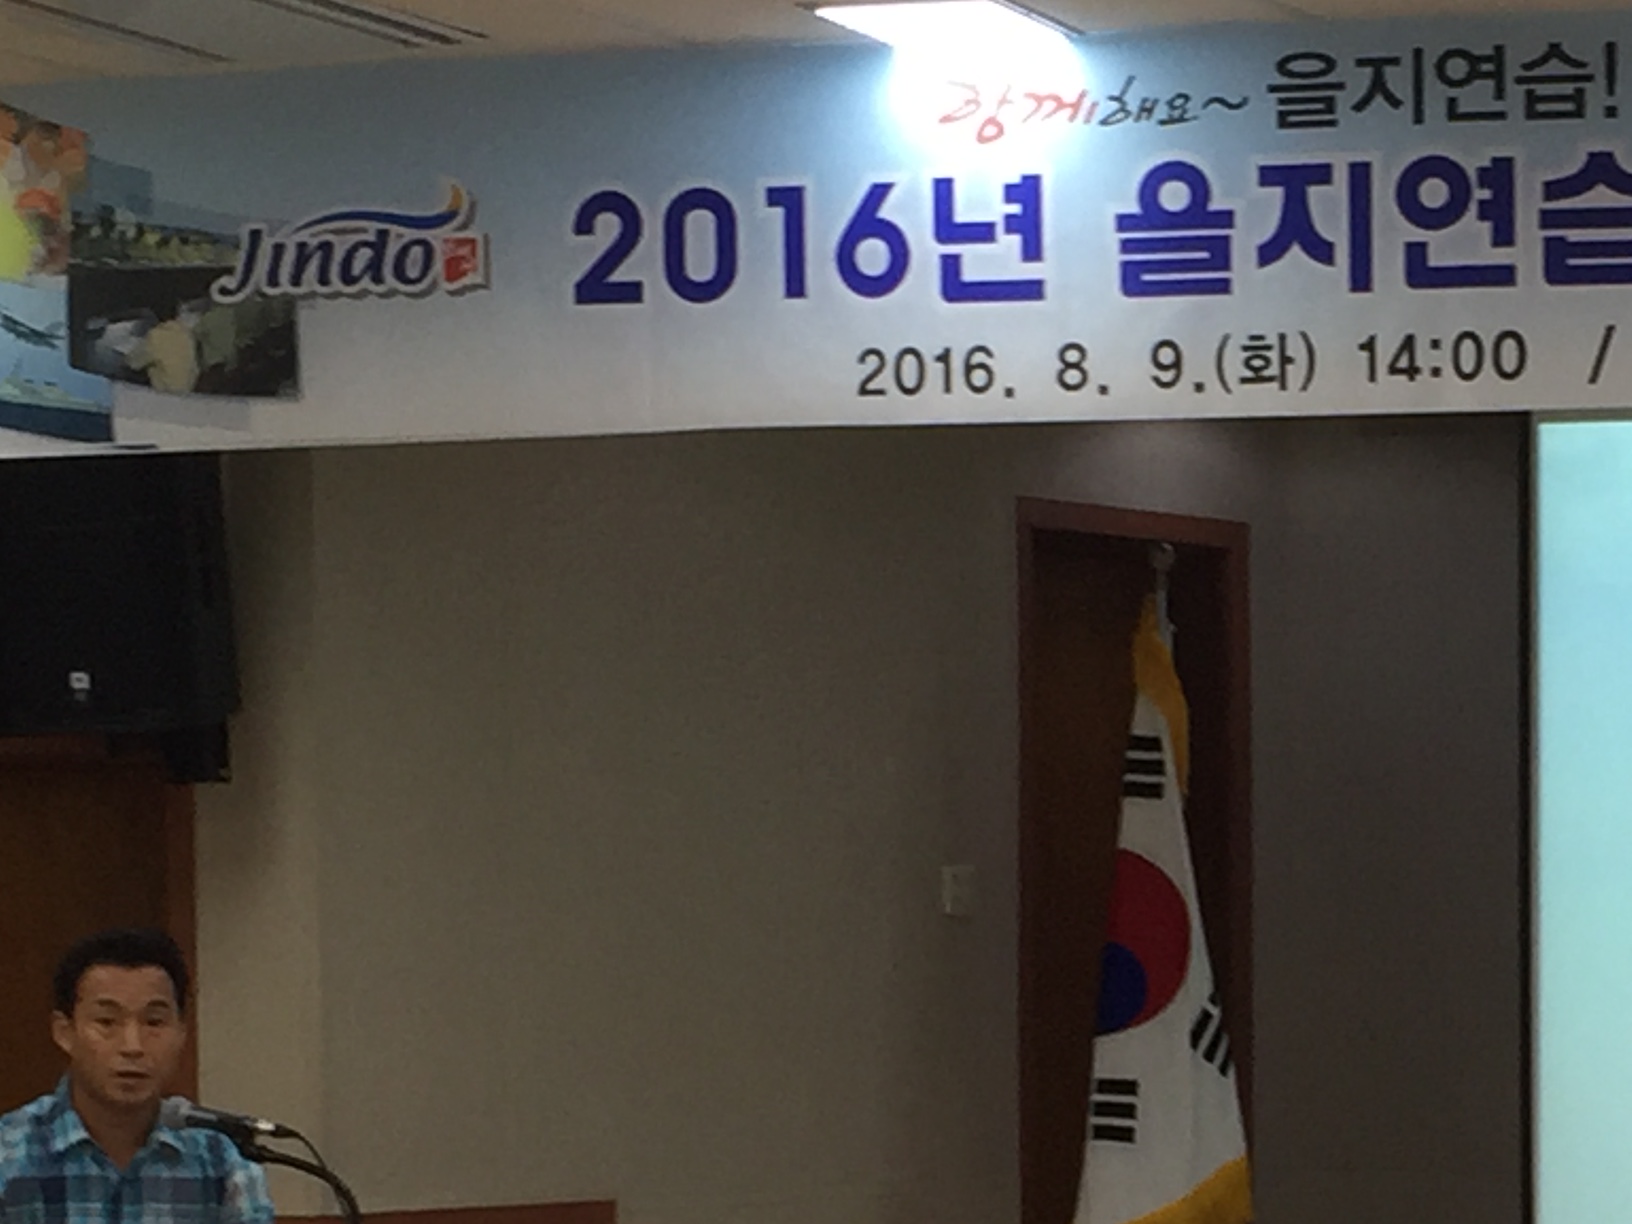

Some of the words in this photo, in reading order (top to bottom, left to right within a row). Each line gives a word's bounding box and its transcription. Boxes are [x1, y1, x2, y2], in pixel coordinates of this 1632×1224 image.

[1267, 42, 1617, 130] 을지연습!
[573, 174, 1046, 305] 2016년
[856, 346, 1016, 400] 2016.
[1055, 341, 1111, 396] 8.
[1357, 329, 1529, 386] 14:00
[1588, 324, 1617, 386] /
